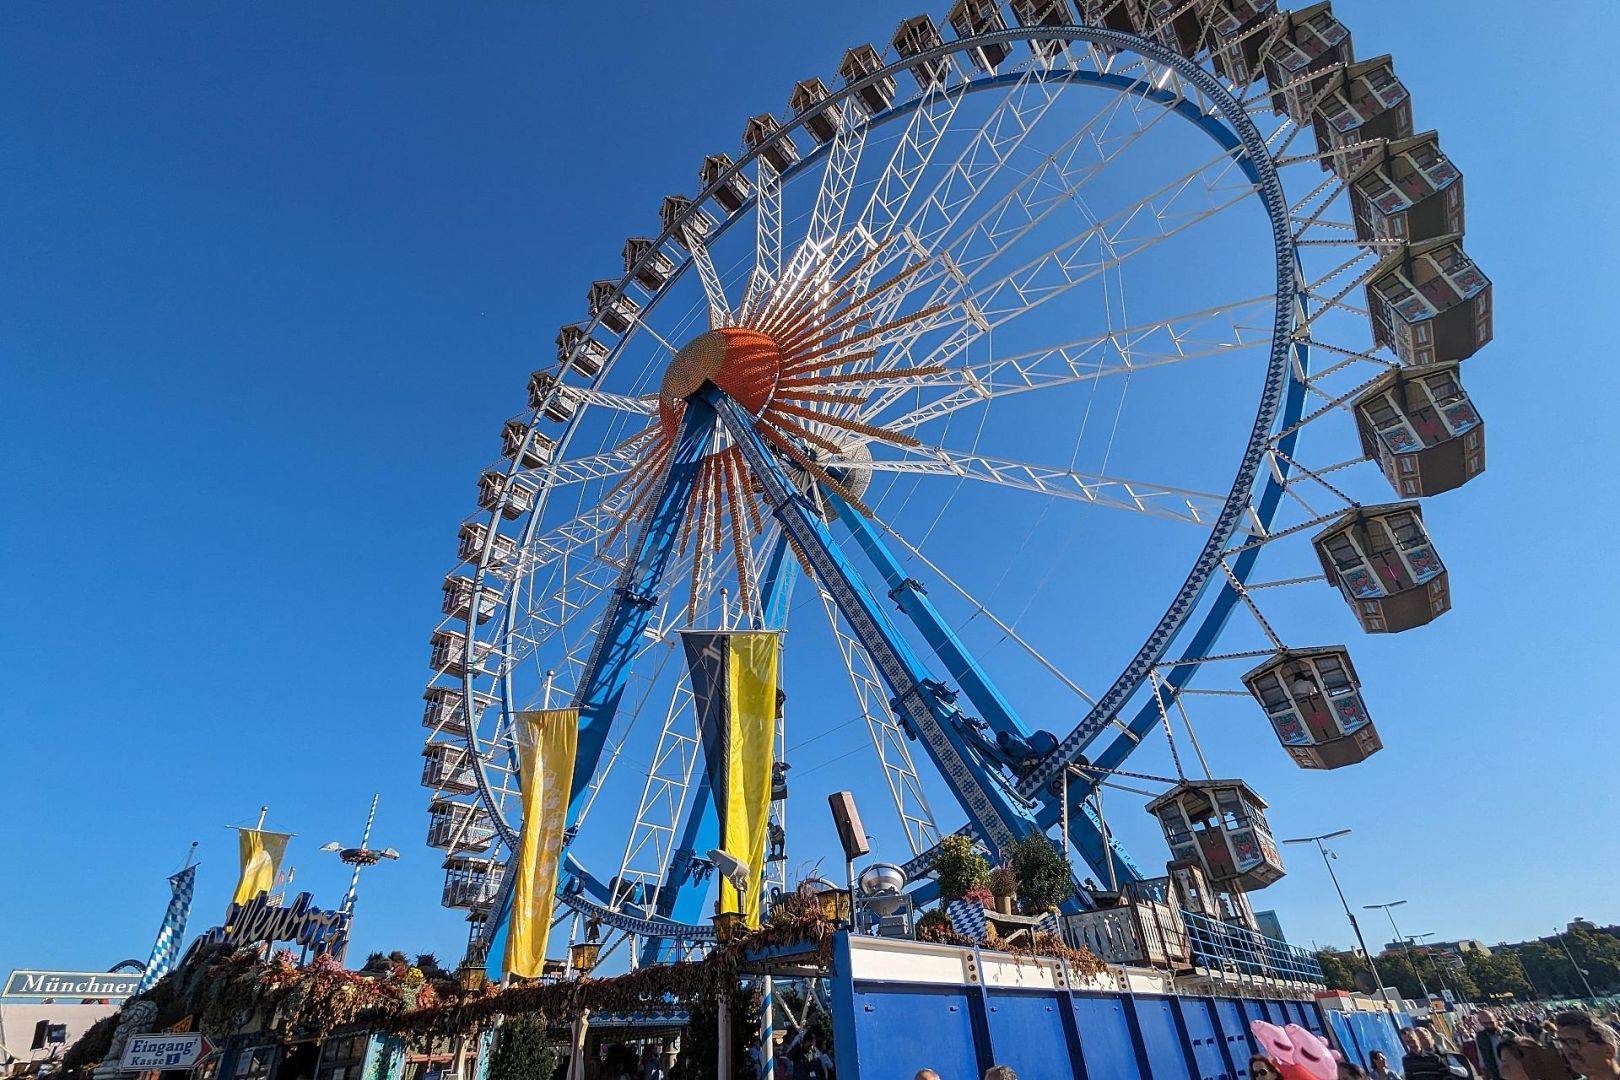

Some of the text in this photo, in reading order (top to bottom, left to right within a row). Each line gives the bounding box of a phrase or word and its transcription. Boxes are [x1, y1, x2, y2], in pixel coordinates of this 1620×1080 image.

[20, 974, 138, 993] Münchner
[131, 1040, 194, 1056] Eingang
[131, 1056, 164, 1066] Kasse
